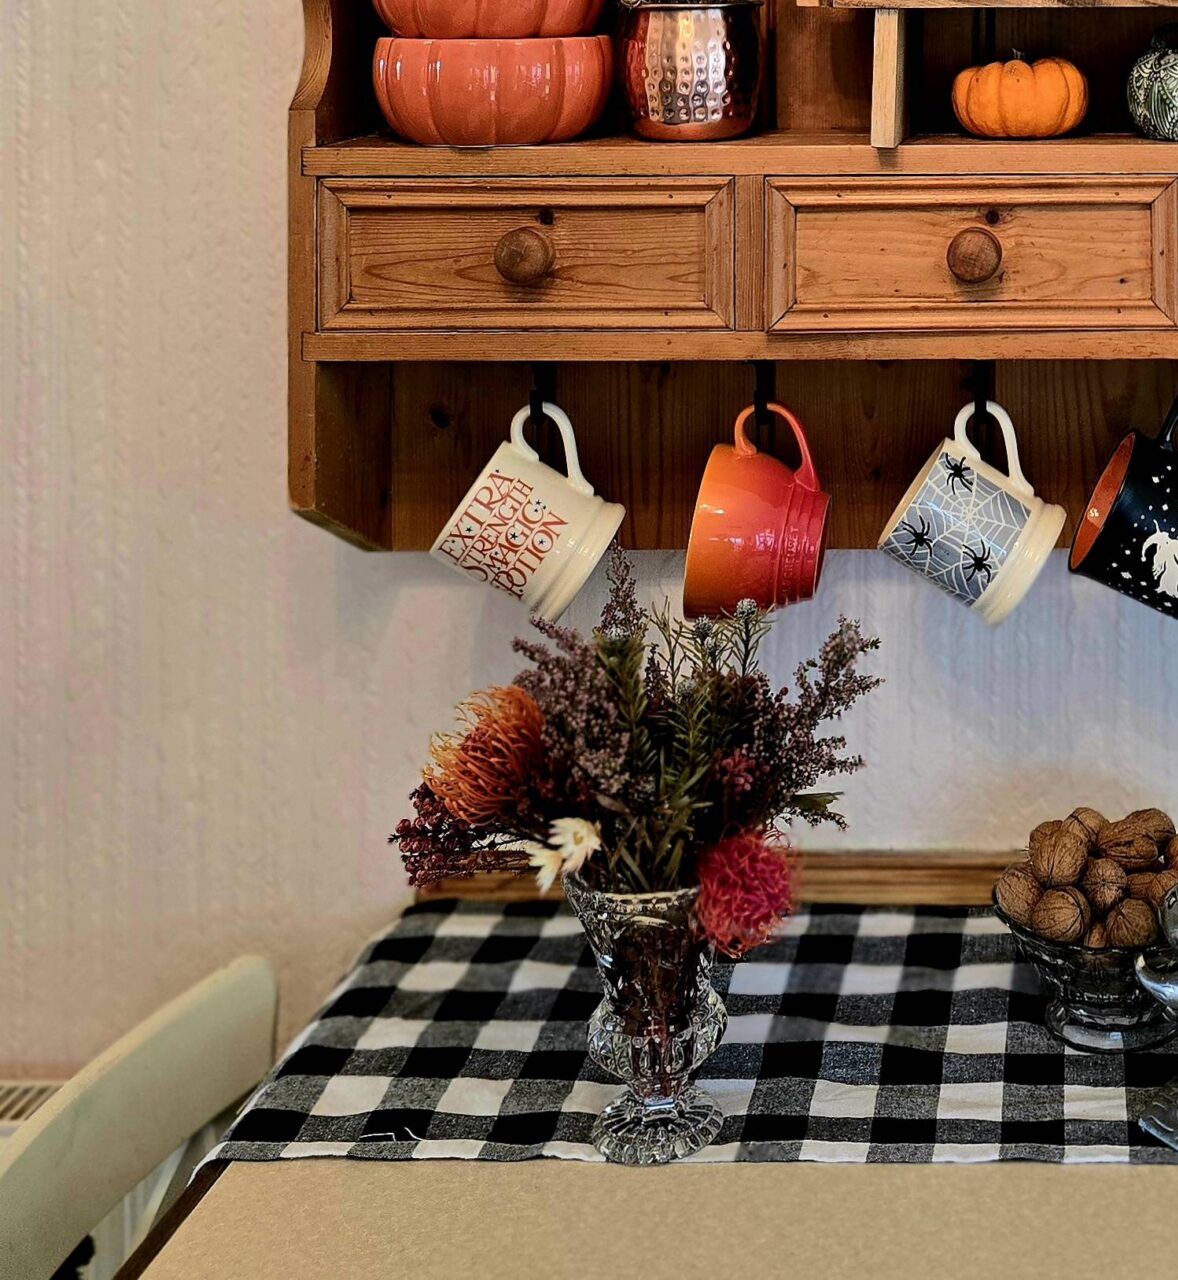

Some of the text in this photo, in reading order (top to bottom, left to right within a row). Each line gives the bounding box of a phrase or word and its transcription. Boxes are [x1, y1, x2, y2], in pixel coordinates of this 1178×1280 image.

[438, 472, 516, 566] EXTRA
[459, 478, 534, 582] STRENGTH
[483, 498, 544, 579] MAGIC
[490, 511, 568, 600] POTION
